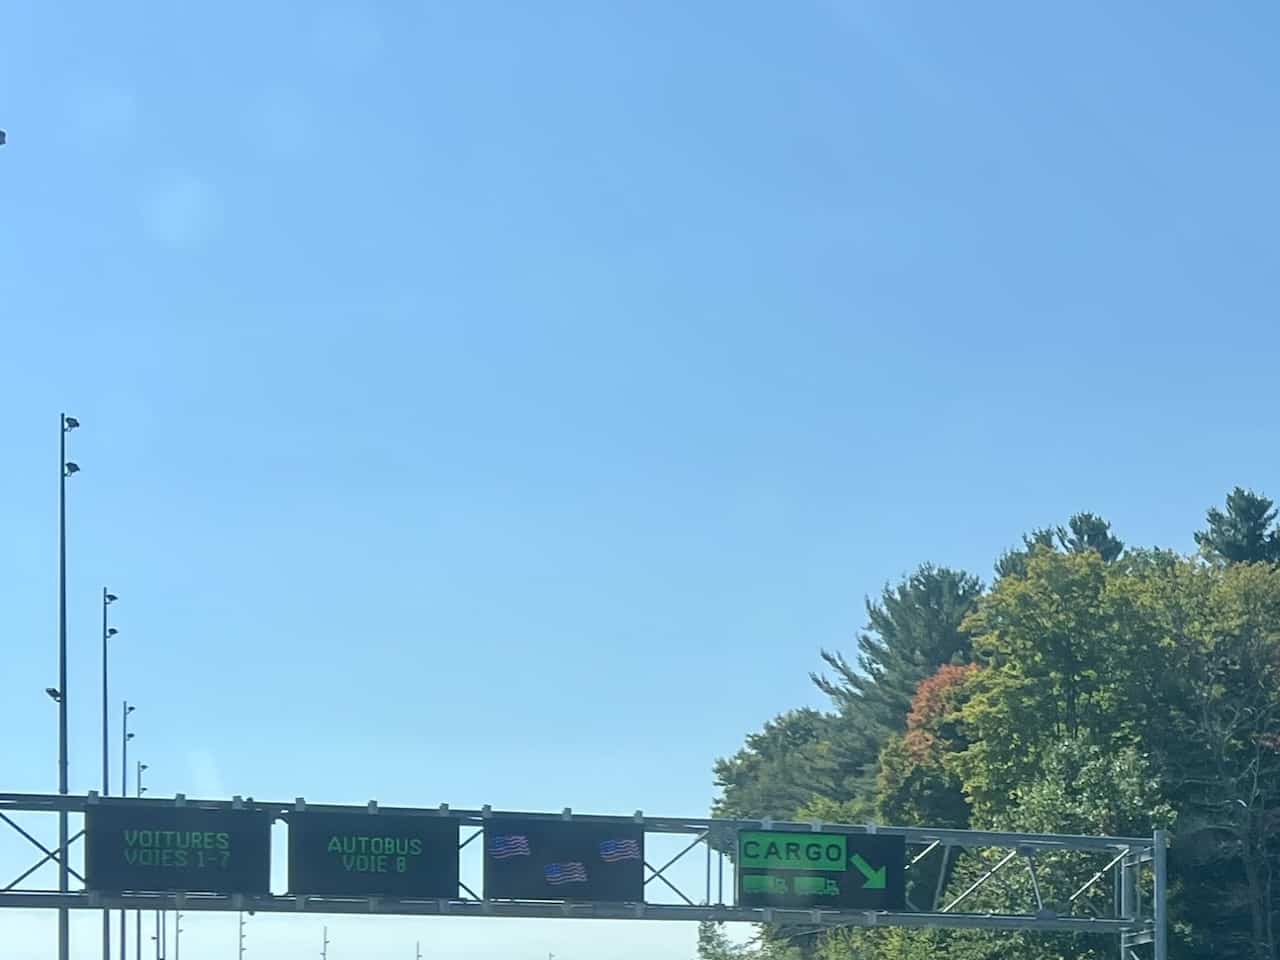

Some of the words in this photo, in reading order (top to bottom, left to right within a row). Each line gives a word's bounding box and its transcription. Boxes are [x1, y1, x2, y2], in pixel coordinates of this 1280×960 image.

[124, 830, 230, 849] VOITURES
[328, 836, 423, 856] AUTOBUS
[124, 849, 188, 866] VOIES
[198, 851, 231, 868] 1-7
[743, 840, 842, 862] CARGO
[343, 855, 387, 872] VOIE
